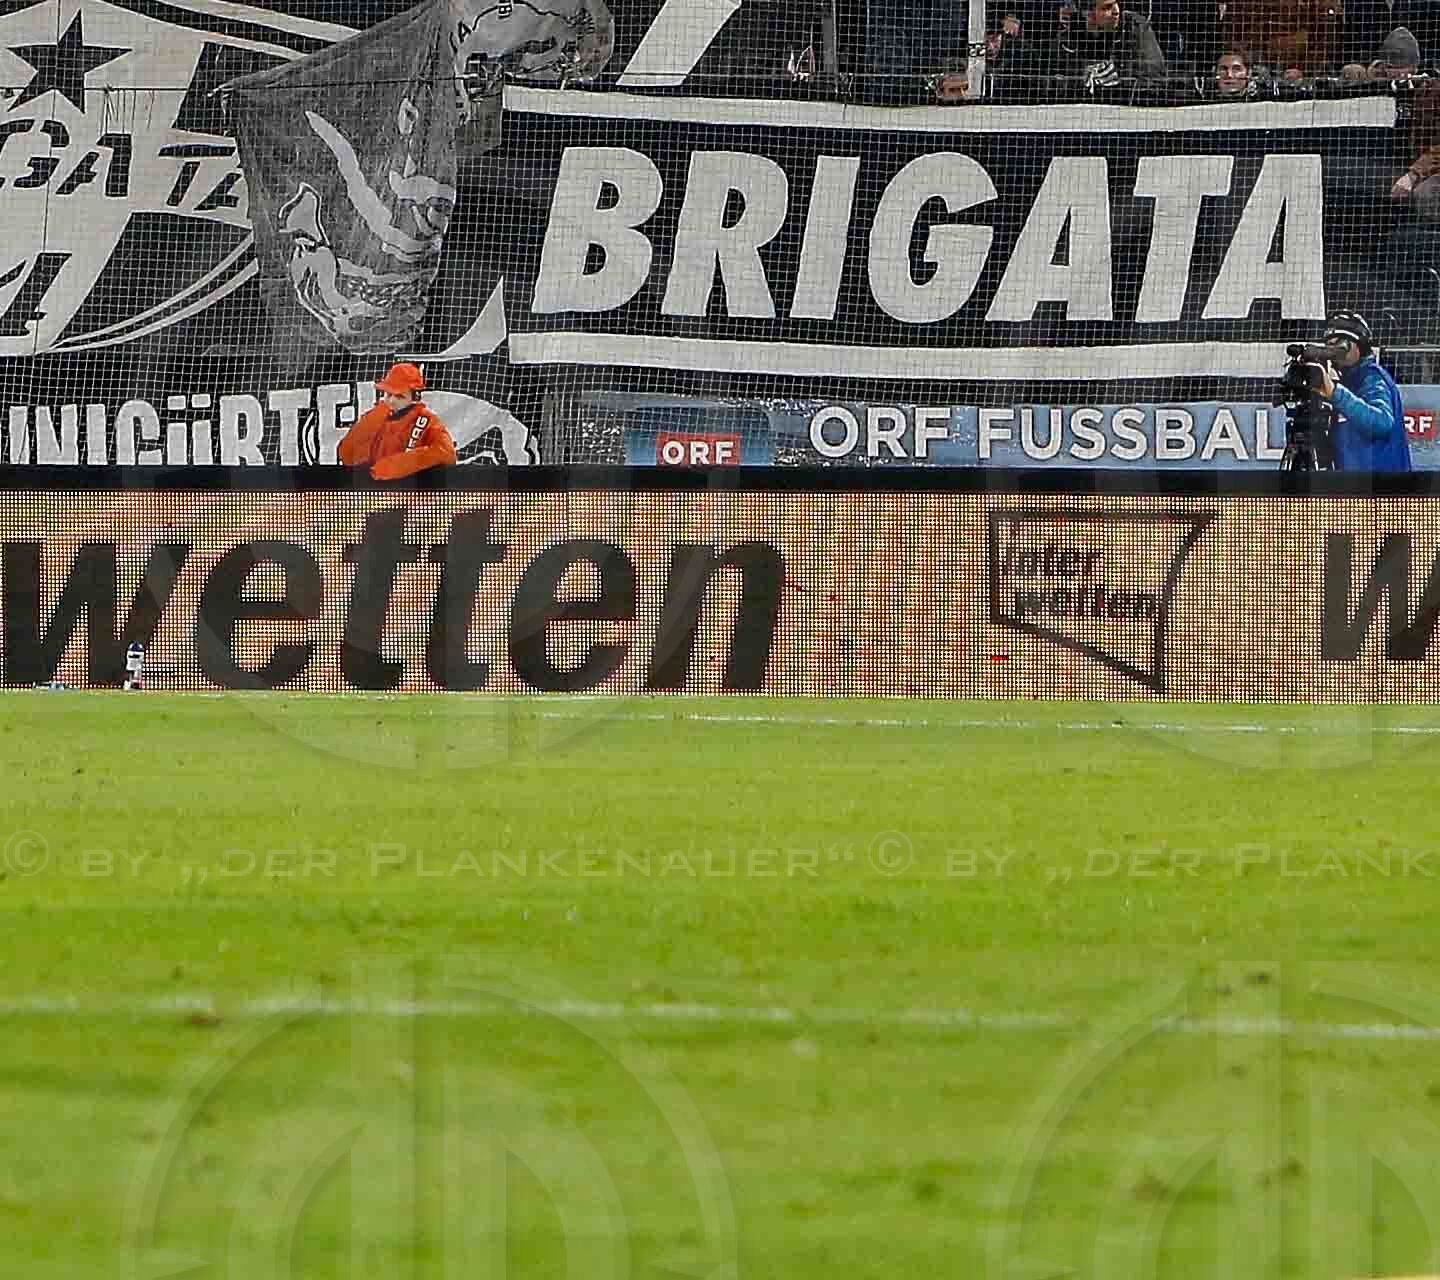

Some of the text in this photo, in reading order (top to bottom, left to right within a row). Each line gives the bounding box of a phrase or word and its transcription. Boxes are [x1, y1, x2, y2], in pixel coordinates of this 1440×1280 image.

[530, 144, 1326, 326] BRIGATA
[808, 401, 1286, 461] ORF FUSSBAL
[1404, 412, 1435, 437] RF
[661, 437, 736, 464] ORF
